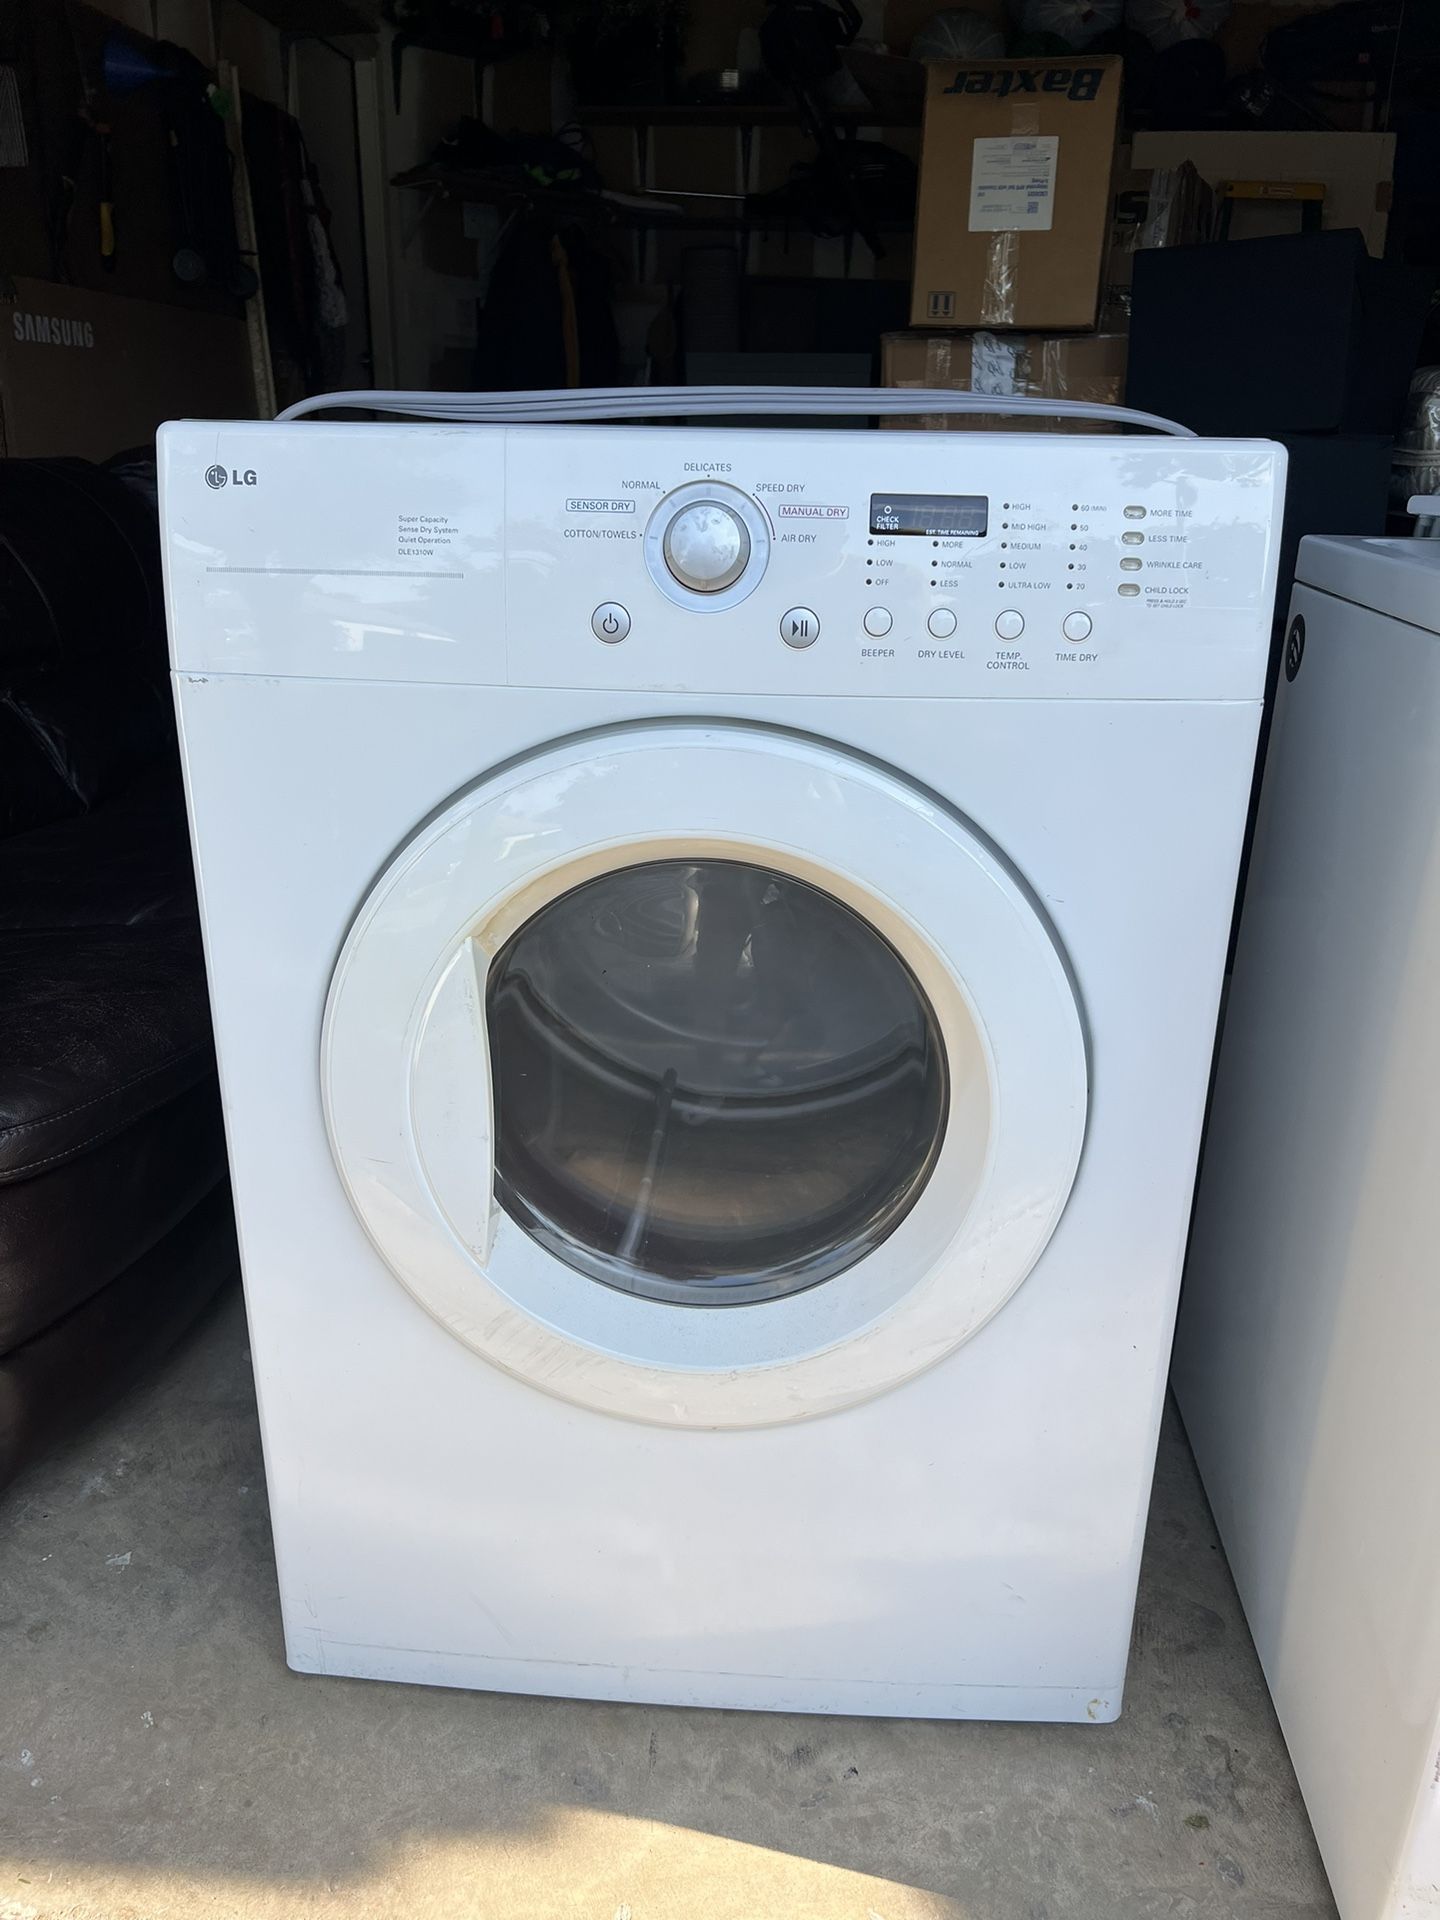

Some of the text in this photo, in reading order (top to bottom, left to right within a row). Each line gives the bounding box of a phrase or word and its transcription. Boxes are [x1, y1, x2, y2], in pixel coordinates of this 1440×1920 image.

[943, 69, 1104, 100] Baxter
[13, 311, 94, 347] SAMSUNG
[683, 463, 732, 472] DELICATES
[232, 469, 257, 486] LG
[621, 480, 660, 490] NORMAL
[755, 483, 805, 493] SPEED DRY
[570, 501, 630, 511] SENSOR DRY
[1012, 503, 1031, 511] HIGH
[1081, 504, 1090, 512] 60
[781, 507, 847, 517] MANUAL DRY
[1150, 509, 1193, 518] MORE TIME
[398, 515, 448, 524] Super Capacity
[398, 525, 459, 534] Sense Dry System
[1011, 523, 1047, 531] MID HIGH
[1079, 524, 1089, 532] 50
[564, 529, 637, 539] COTTON/TOWELS
[418, 536, 451, 544] Operation
[781, 534, 817, 543] AIR DRY
[1148, 535, 1166, 543] LESS
[877, 539, 896, 547] HIGH
[1010, 542, 1041, 550] MEDIUM
[876, 559, 893, 567] LOW
[941, 560, 973, 568] NORMAL
[1009, 562, 1026, 570] LOW
[1077, 563, 1087, 571] 30
[1146, 561, 1180, 569] WRINKLE
[875, 578, 889, 586] OFF
[940, 580, 958, 588] LESS
[1032, 582, 1051, 590] LOW
[861, 649, 895, 658] BEEPER
[917, 650, 965, 660] DRY LEVEL
[996, 652, 1022, 660] TEMP.
[1055, 653, 1098, 662] TIME DRY
[986, 661, 1030, 671] CONTROL
